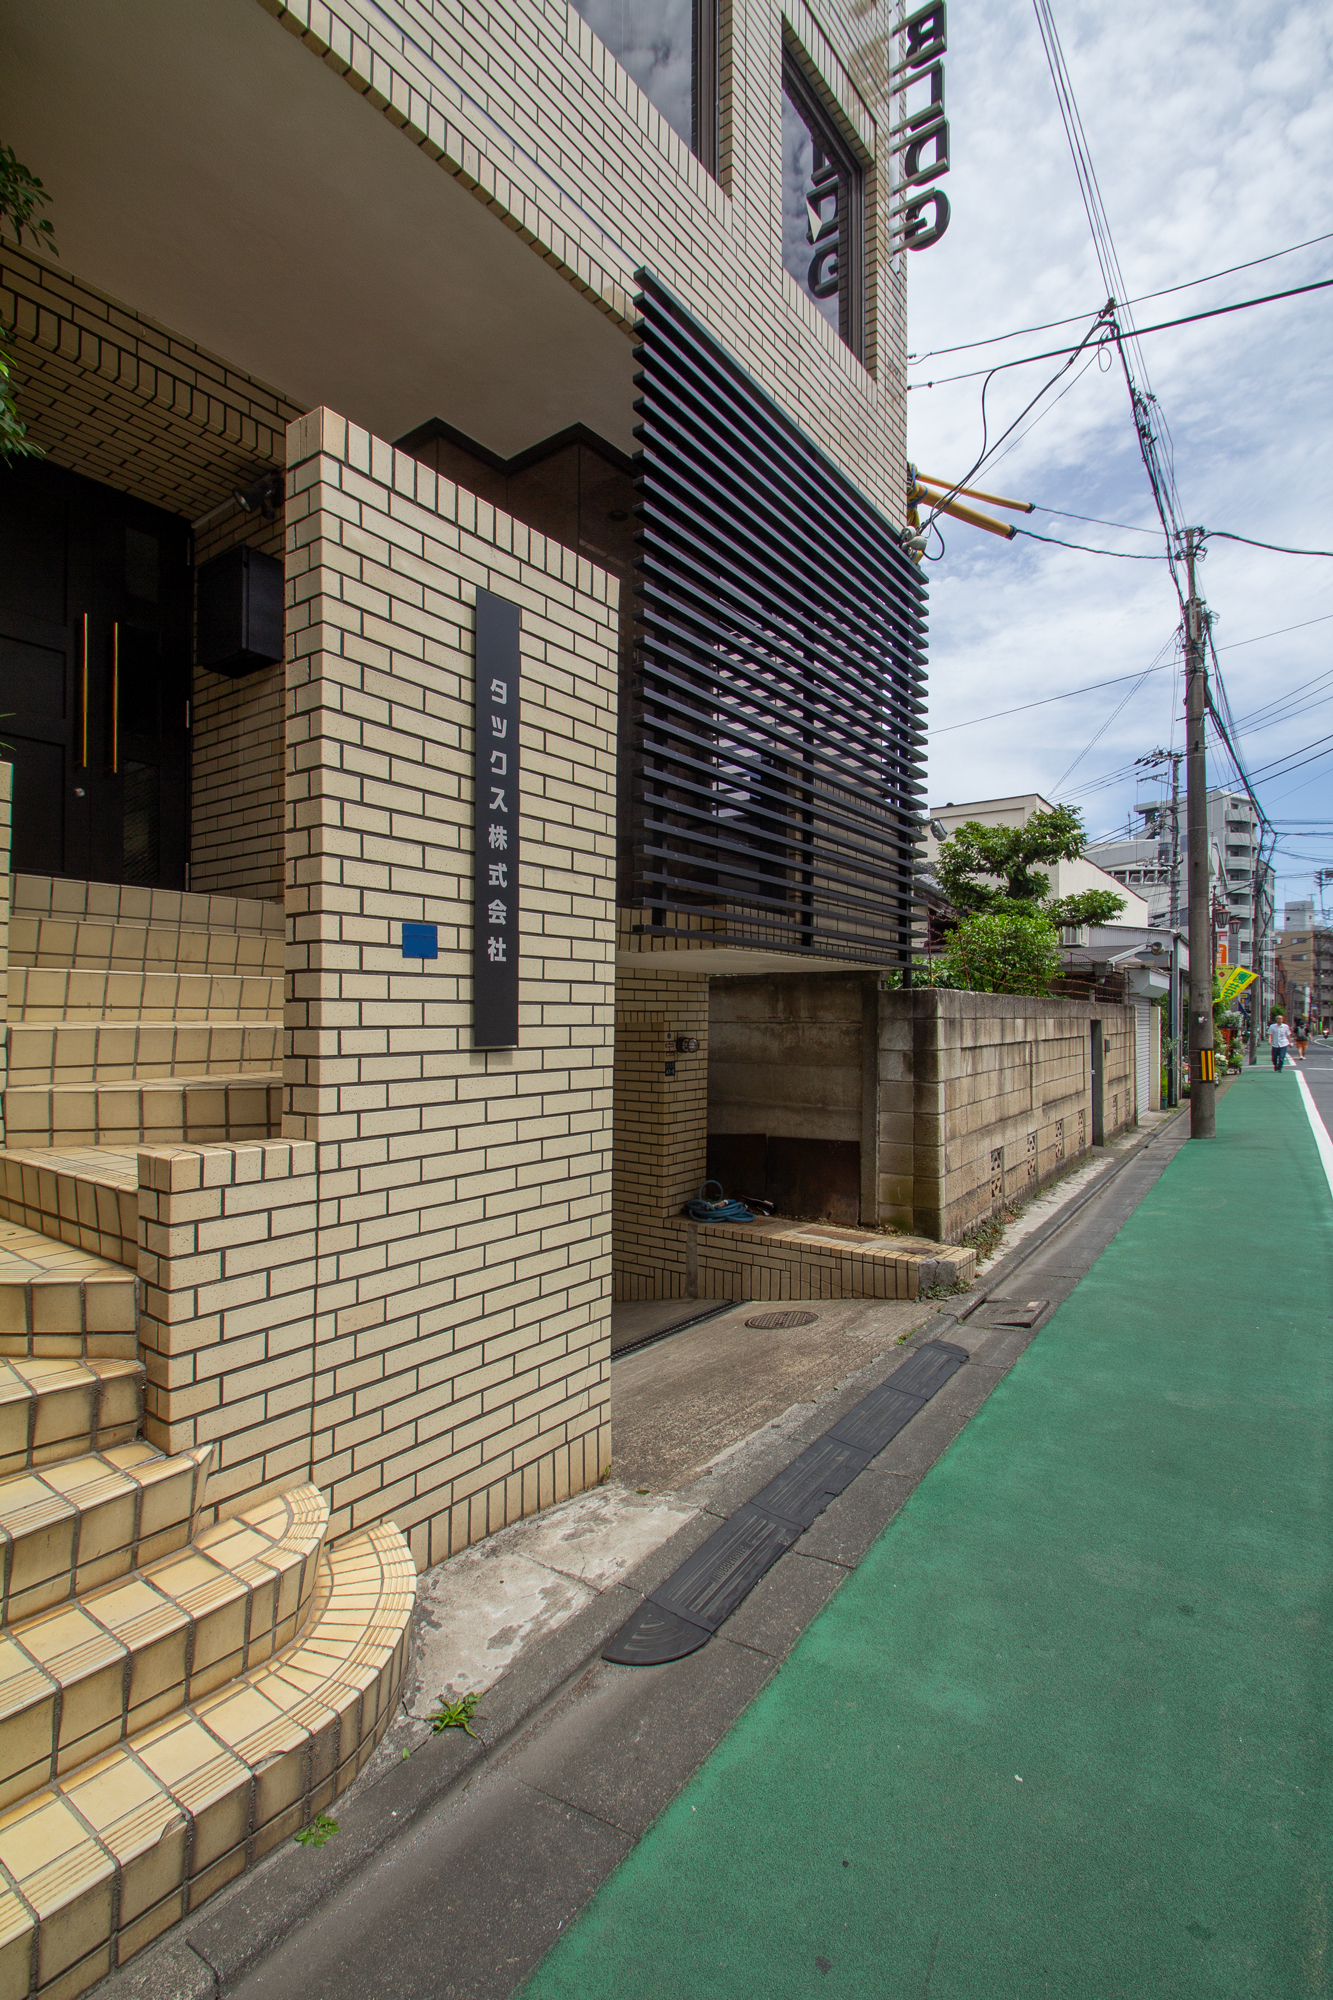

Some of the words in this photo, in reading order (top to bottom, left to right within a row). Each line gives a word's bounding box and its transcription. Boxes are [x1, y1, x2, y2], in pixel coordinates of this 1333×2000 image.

[487, 678, 508, 962] タックス株式会社
